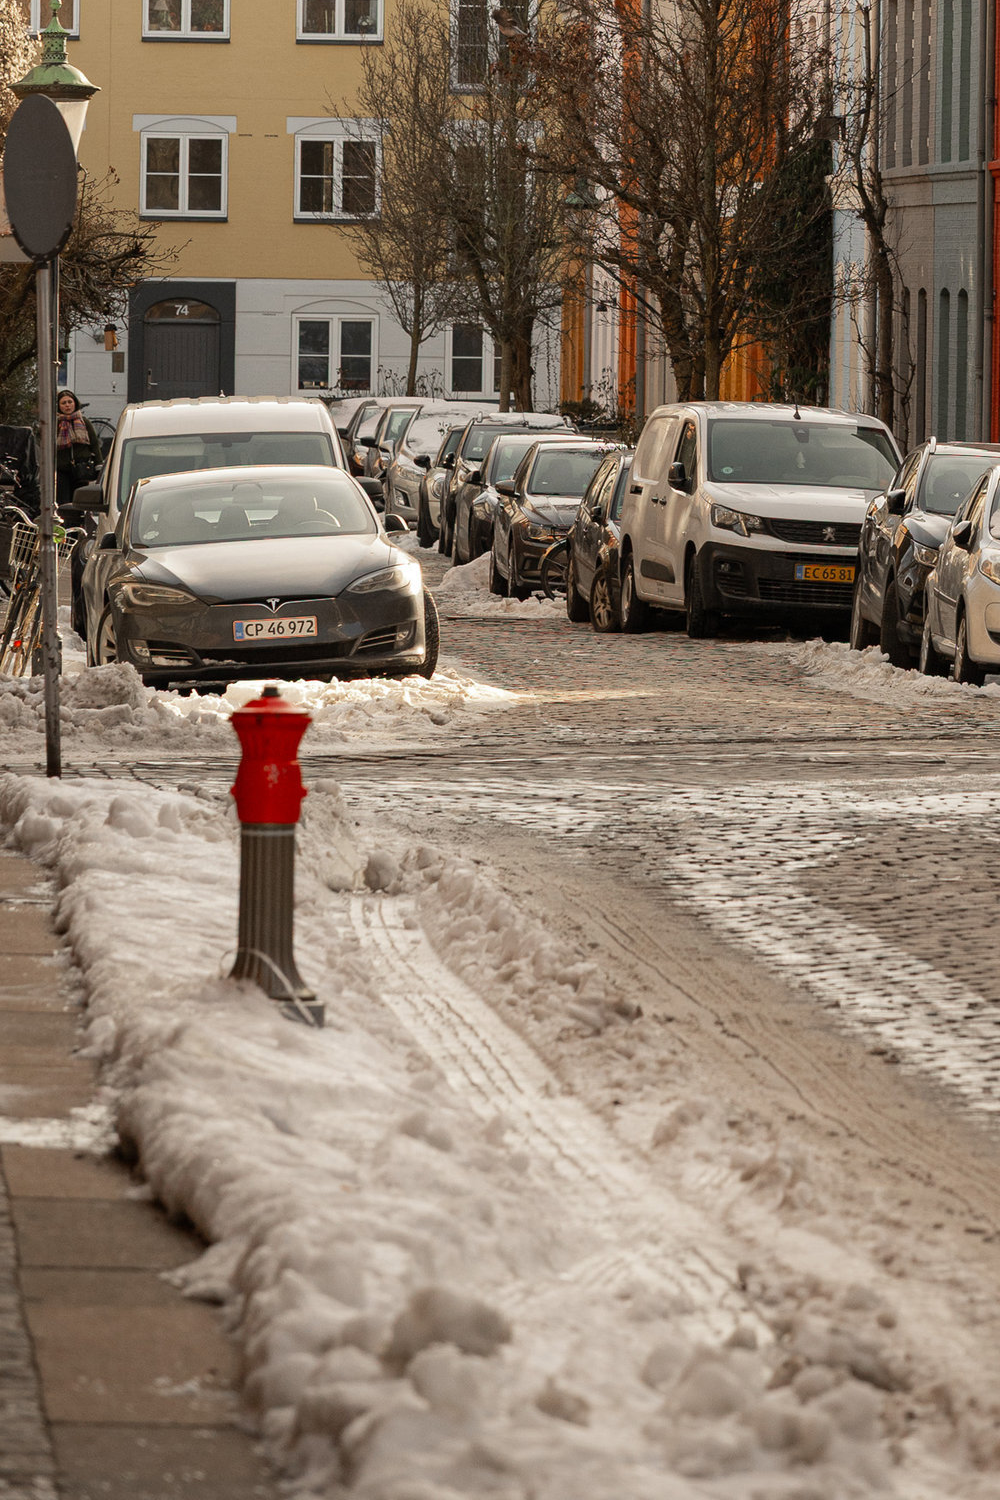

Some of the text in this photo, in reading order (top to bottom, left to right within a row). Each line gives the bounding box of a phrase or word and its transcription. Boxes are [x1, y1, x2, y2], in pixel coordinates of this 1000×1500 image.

[174, 304, 190, 316] 74
[804, 567, 820, 579] EC
[822, 568, 836, 580] 65
[245, 623, 264, 637] CP
[267, 621, 285, 635] 46
[288, 619, 314, 634] 972
